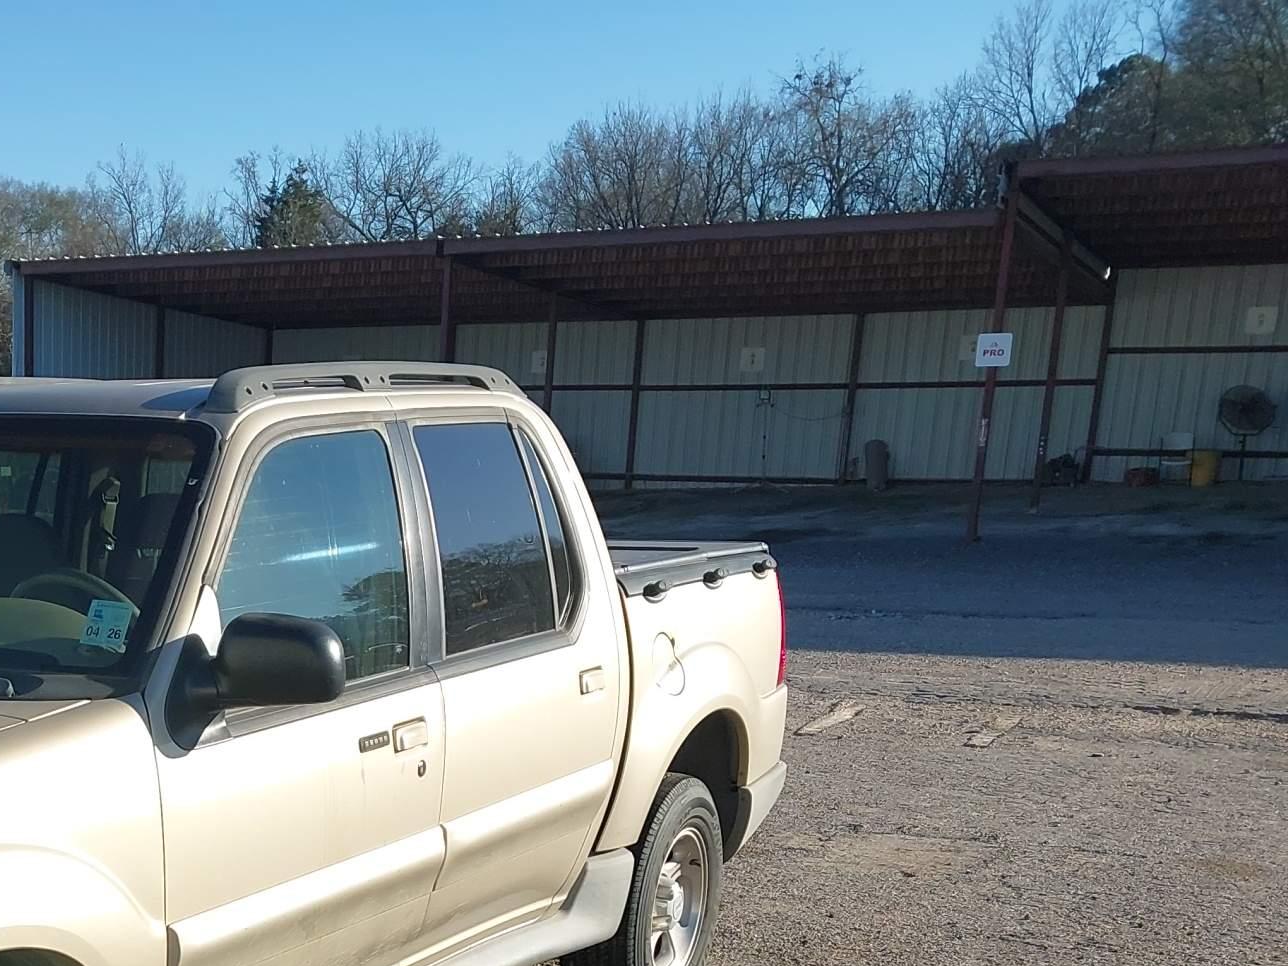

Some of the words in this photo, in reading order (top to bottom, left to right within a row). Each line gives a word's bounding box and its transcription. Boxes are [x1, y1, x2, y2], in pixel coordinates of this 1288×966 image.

[983, 349, 1005, 357] PRO
[86, 625, 100, 638] 04
[107, 628, 122, 640] 26
